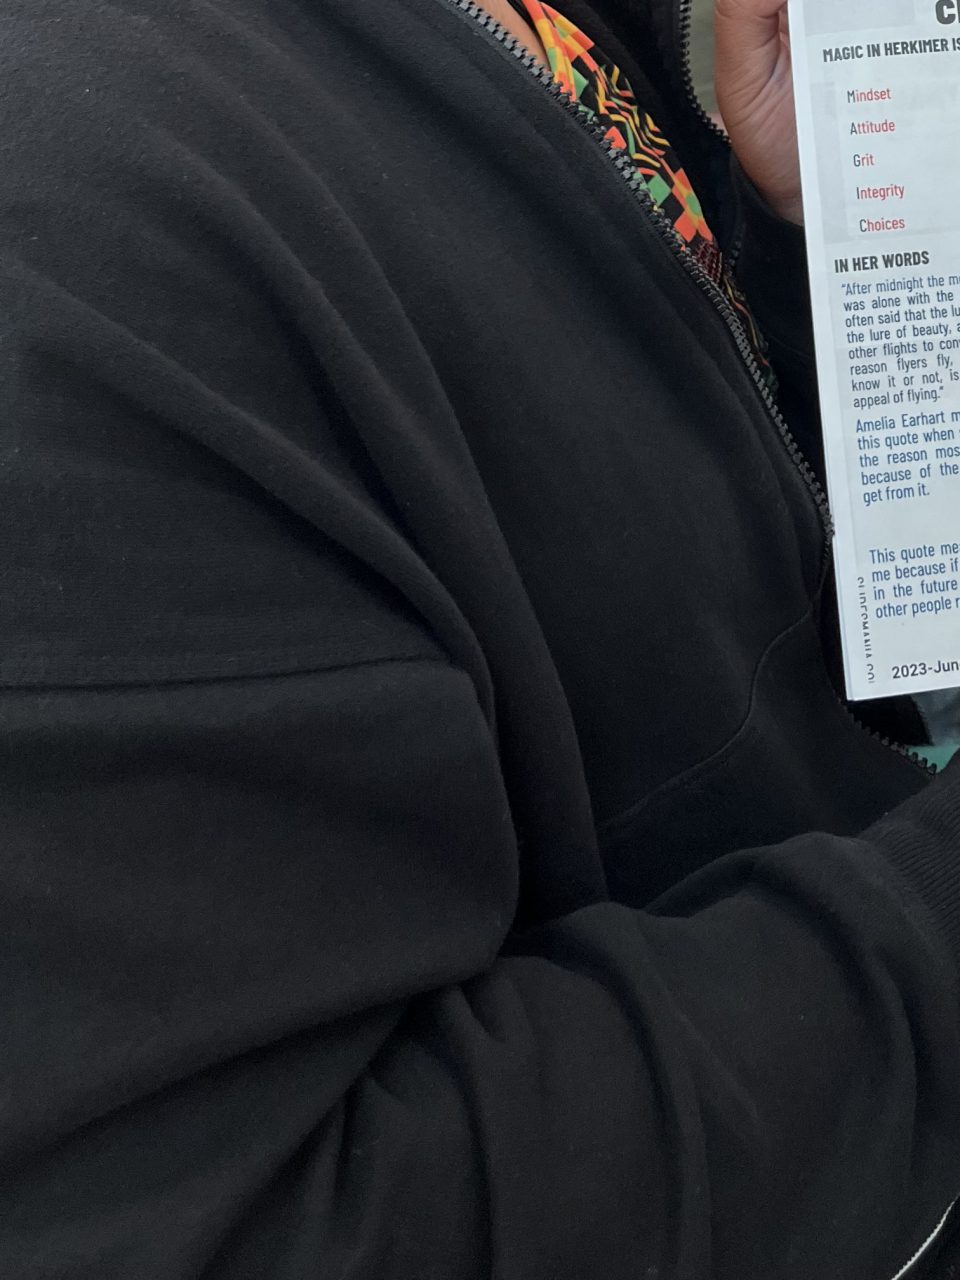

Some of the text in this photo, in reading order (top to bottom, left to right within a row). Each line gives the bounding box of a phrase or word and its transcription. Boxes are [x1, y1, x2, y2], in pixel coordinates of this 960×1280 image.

[823, 45, 863, 62] MAGIC
[867, 43, 881, 58] IN
[884, 38, 949, 56] HERKIMER
[847, 88, 891, 103] Mindset
[850, 119, 895, 135] Attitude
[853, 153, 874, 167] Grit
[856, 184, 904, 201] Integrity
[859, 217, 905, 233] Choices
[834, 251, 929, 273] IN HER WORDS
[876, 276, 924, 293] midnight
[927, 275, 945, 288] the
[843, 300, 866, 312] was
[871, 296, 901, 309] alone
[907, 292, 930, 305] with
[936, 290, 954, 302] the
[853, 392, 890, 410] appeal
[893, 390, 904, 403] of
[856, 416, 896, 433] Amelia
[901, 411, 945, 428] Earhart
[857, 435, 880, 450] this
[885, 432, 919, 450] quote
[922, 428, 955, 443] when
[863, 482, 930, 507] get from it.
[869, 548, 896, 564] This
[900, 545, 935, 563] quote
